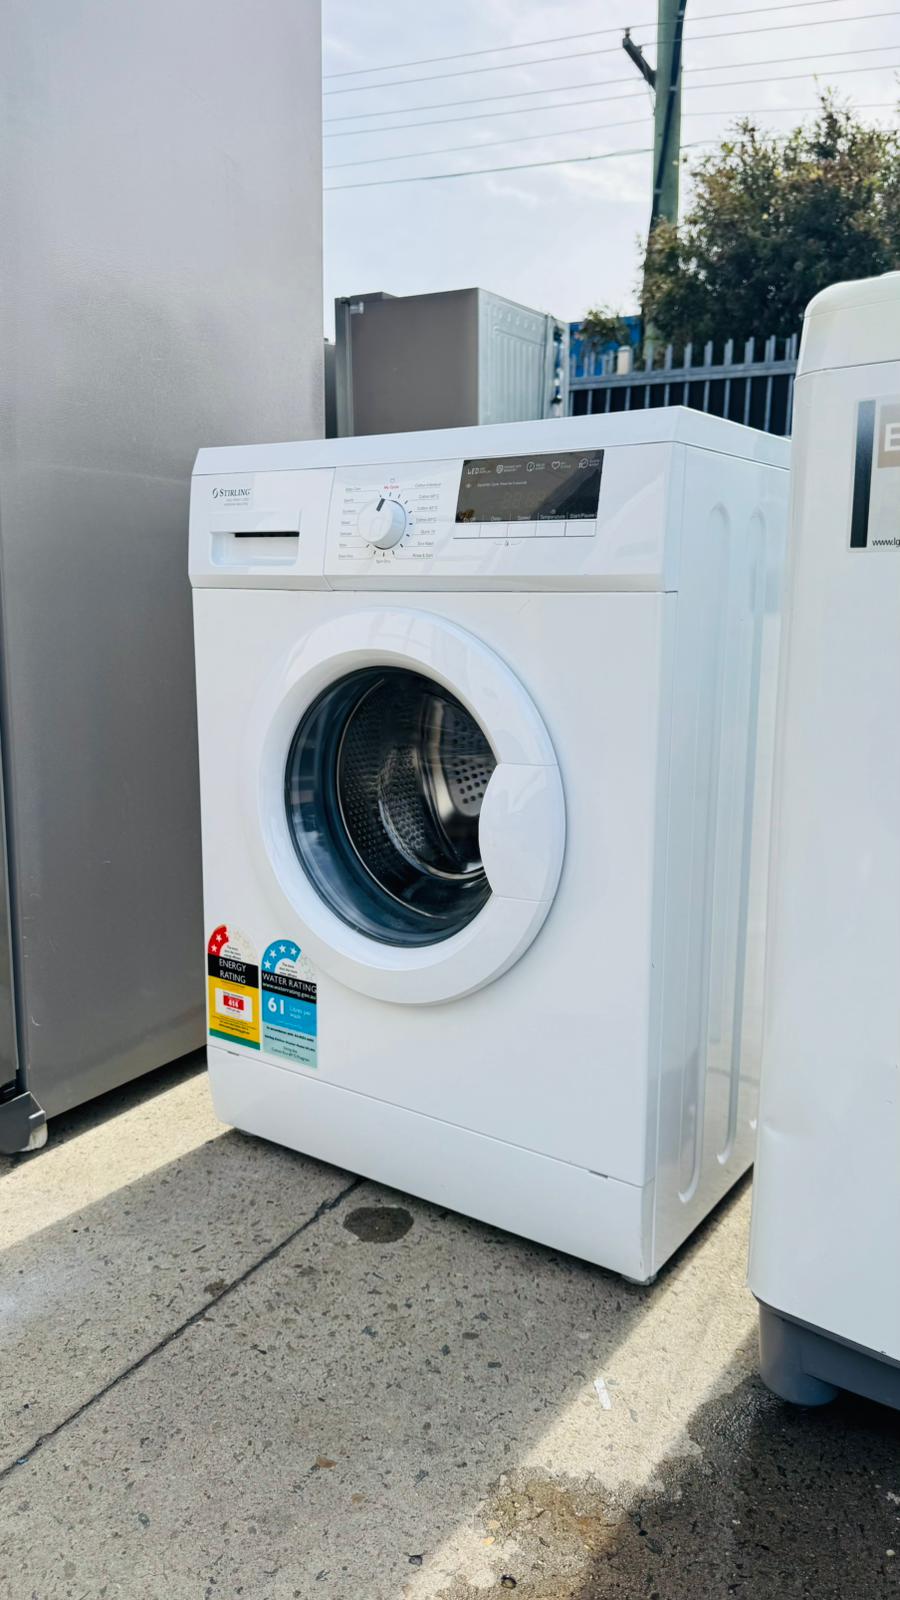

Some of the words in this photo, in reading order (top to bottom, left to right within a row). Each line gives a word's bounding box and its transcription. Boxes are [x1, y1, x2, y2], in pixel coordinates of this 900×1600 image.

[219, 488, 251, 497] STIRLING
[218, 958, 247, 973] ENERGY
[219, 970, 246, 984] RATING
[262, 973, 287, 986] WATER
[288, 979, 317, 993] RATING
[268, 997, 285, 1015] 61
